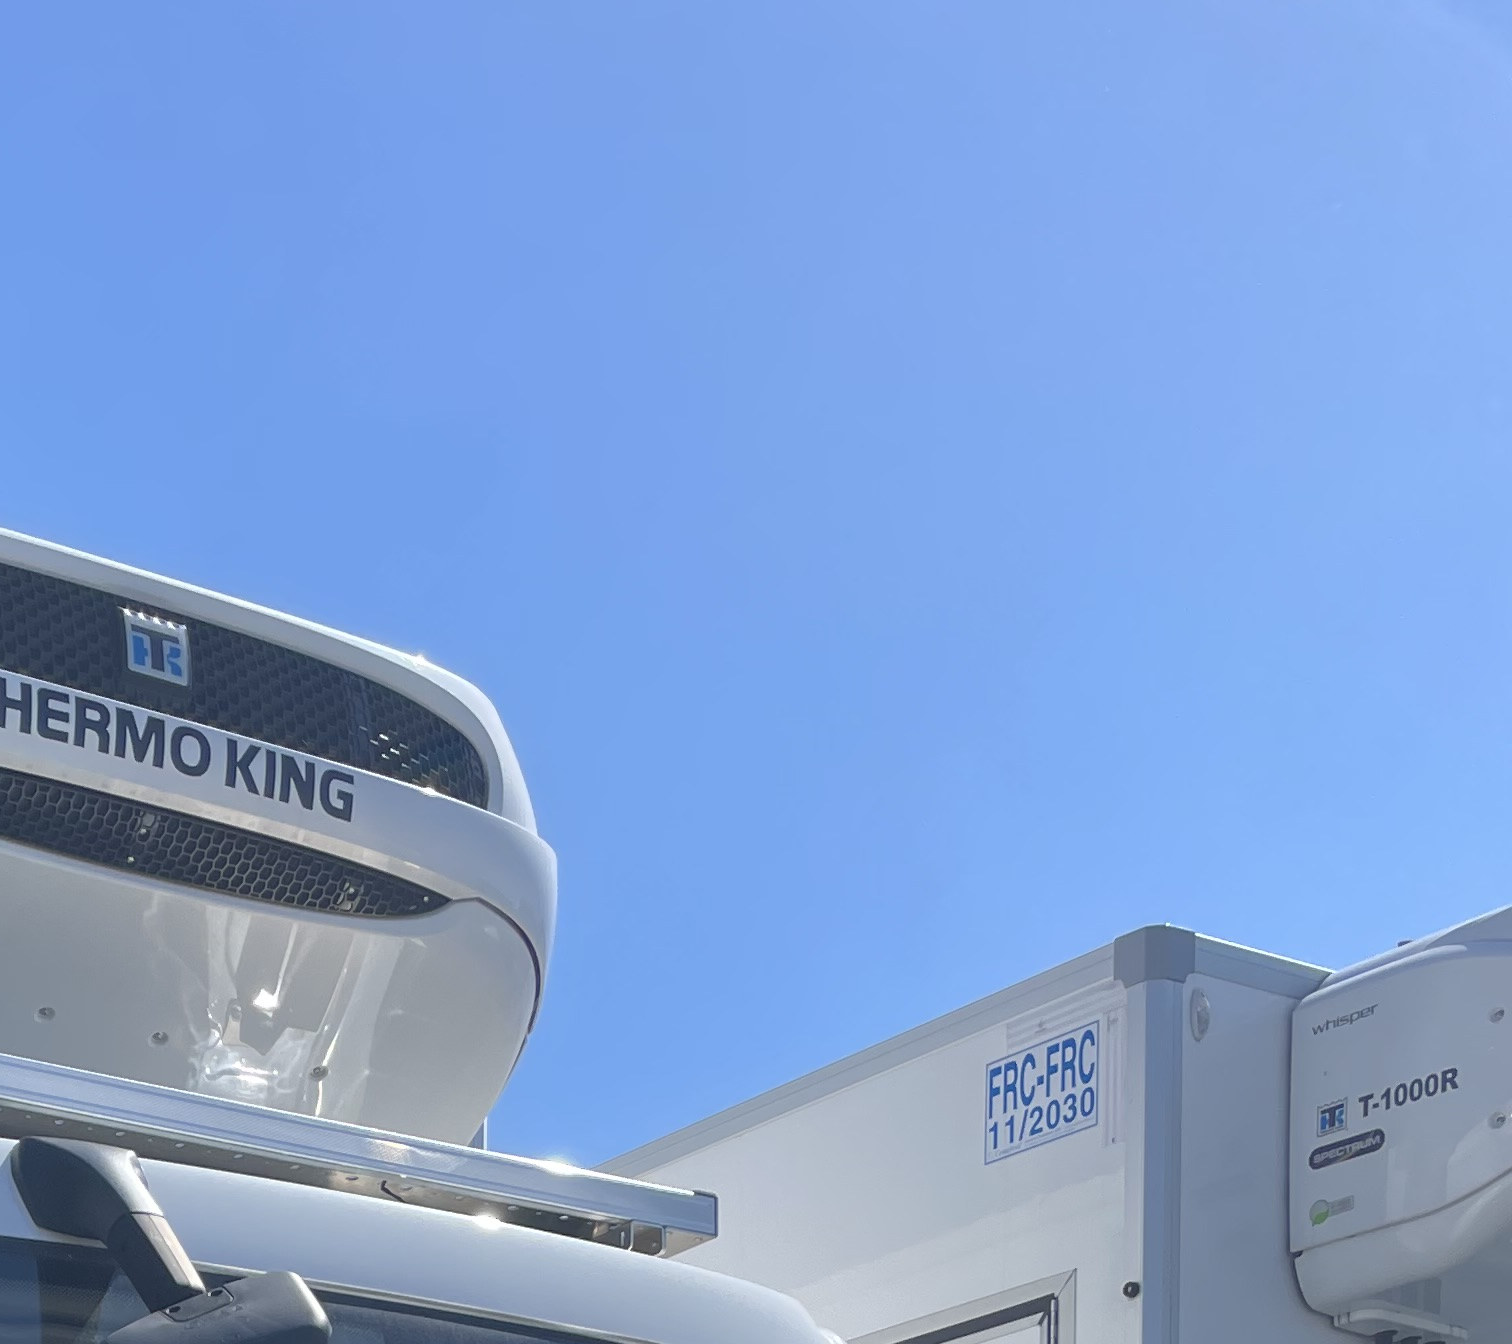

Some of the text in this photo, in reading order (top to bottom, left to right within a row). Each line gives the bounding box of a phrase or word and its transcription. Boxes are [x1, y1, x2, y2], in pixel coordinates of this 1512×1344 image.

[224, 737, 356, 823] KING
[1311, 1004, 1379, 1035] whisper
[988, 1029, 1096, 1120] FRC-FRC
[1358, 1067, 1459, 1118] T-1000R
[988, 1086, 1096, 1150] 11/2030
[1313, 1135, 1382, 1164] SPECTRUM
